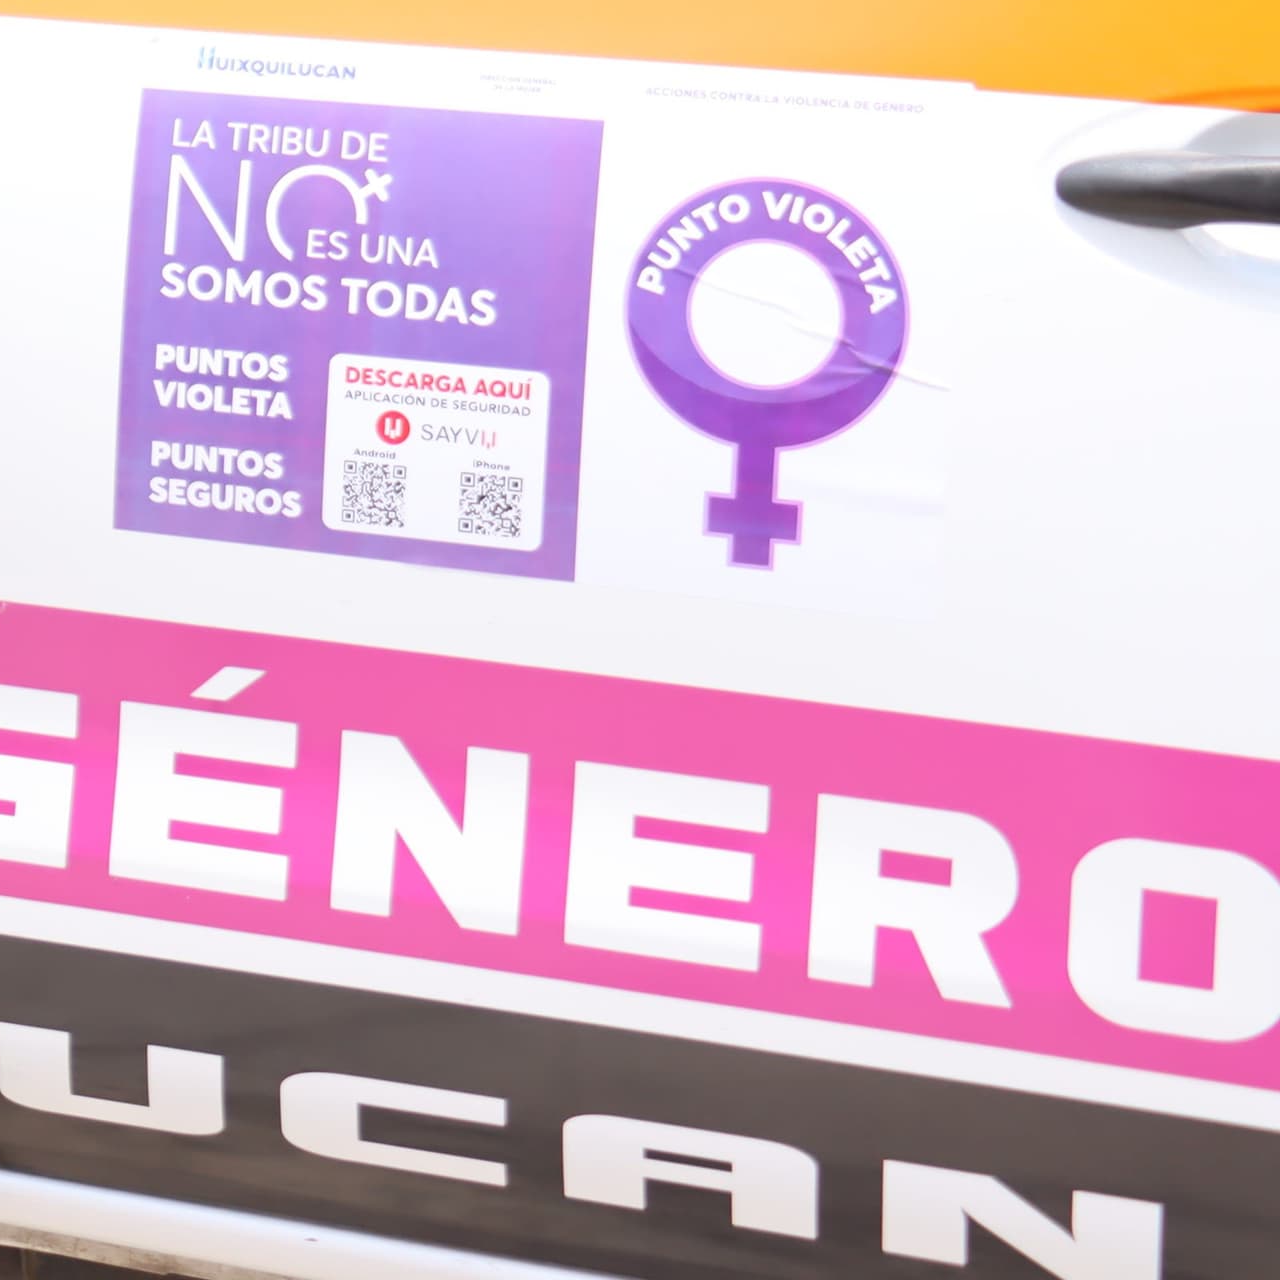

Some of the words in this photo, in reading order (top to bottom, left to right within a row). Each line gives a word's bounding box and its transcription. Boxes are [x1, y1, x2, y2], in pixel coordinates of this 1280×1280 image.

[197, 46, 357, 80] HUIXQUILUCAN
[172, 118, 216, 148] LA
[227, 122, 330, 157] TRIBU
[341, 130, 389, 162] DE
[306, 228, 349, 261] ES
[360, 233, 439, 269] UNA
[636, 193, 751, 296] PUNTO
[761, 190, 898, 315] VIOLETA
[159, 263, 327, 312] SOMOS
[341, 277, 497, 326] TODAS
[154, 343, 289, 382] PUNTOS
[153, 379, 293, 420] VIOLETA
[344, 389, 426, 407] APLICACIÓN
[430, 397, 448, 409] DE
[452, 399, 532, 417] SEGURIDAD
[345, 366, 467, 395] DESCARGA
[473, 378, 533, 401] AQUÍ
[150, 440, 284, 479] PUNTOS
[353, 448, 397, 460] Android
[472, 458, 511, 471] iPhone
[148, 476, 302, 518] SEGUROS
